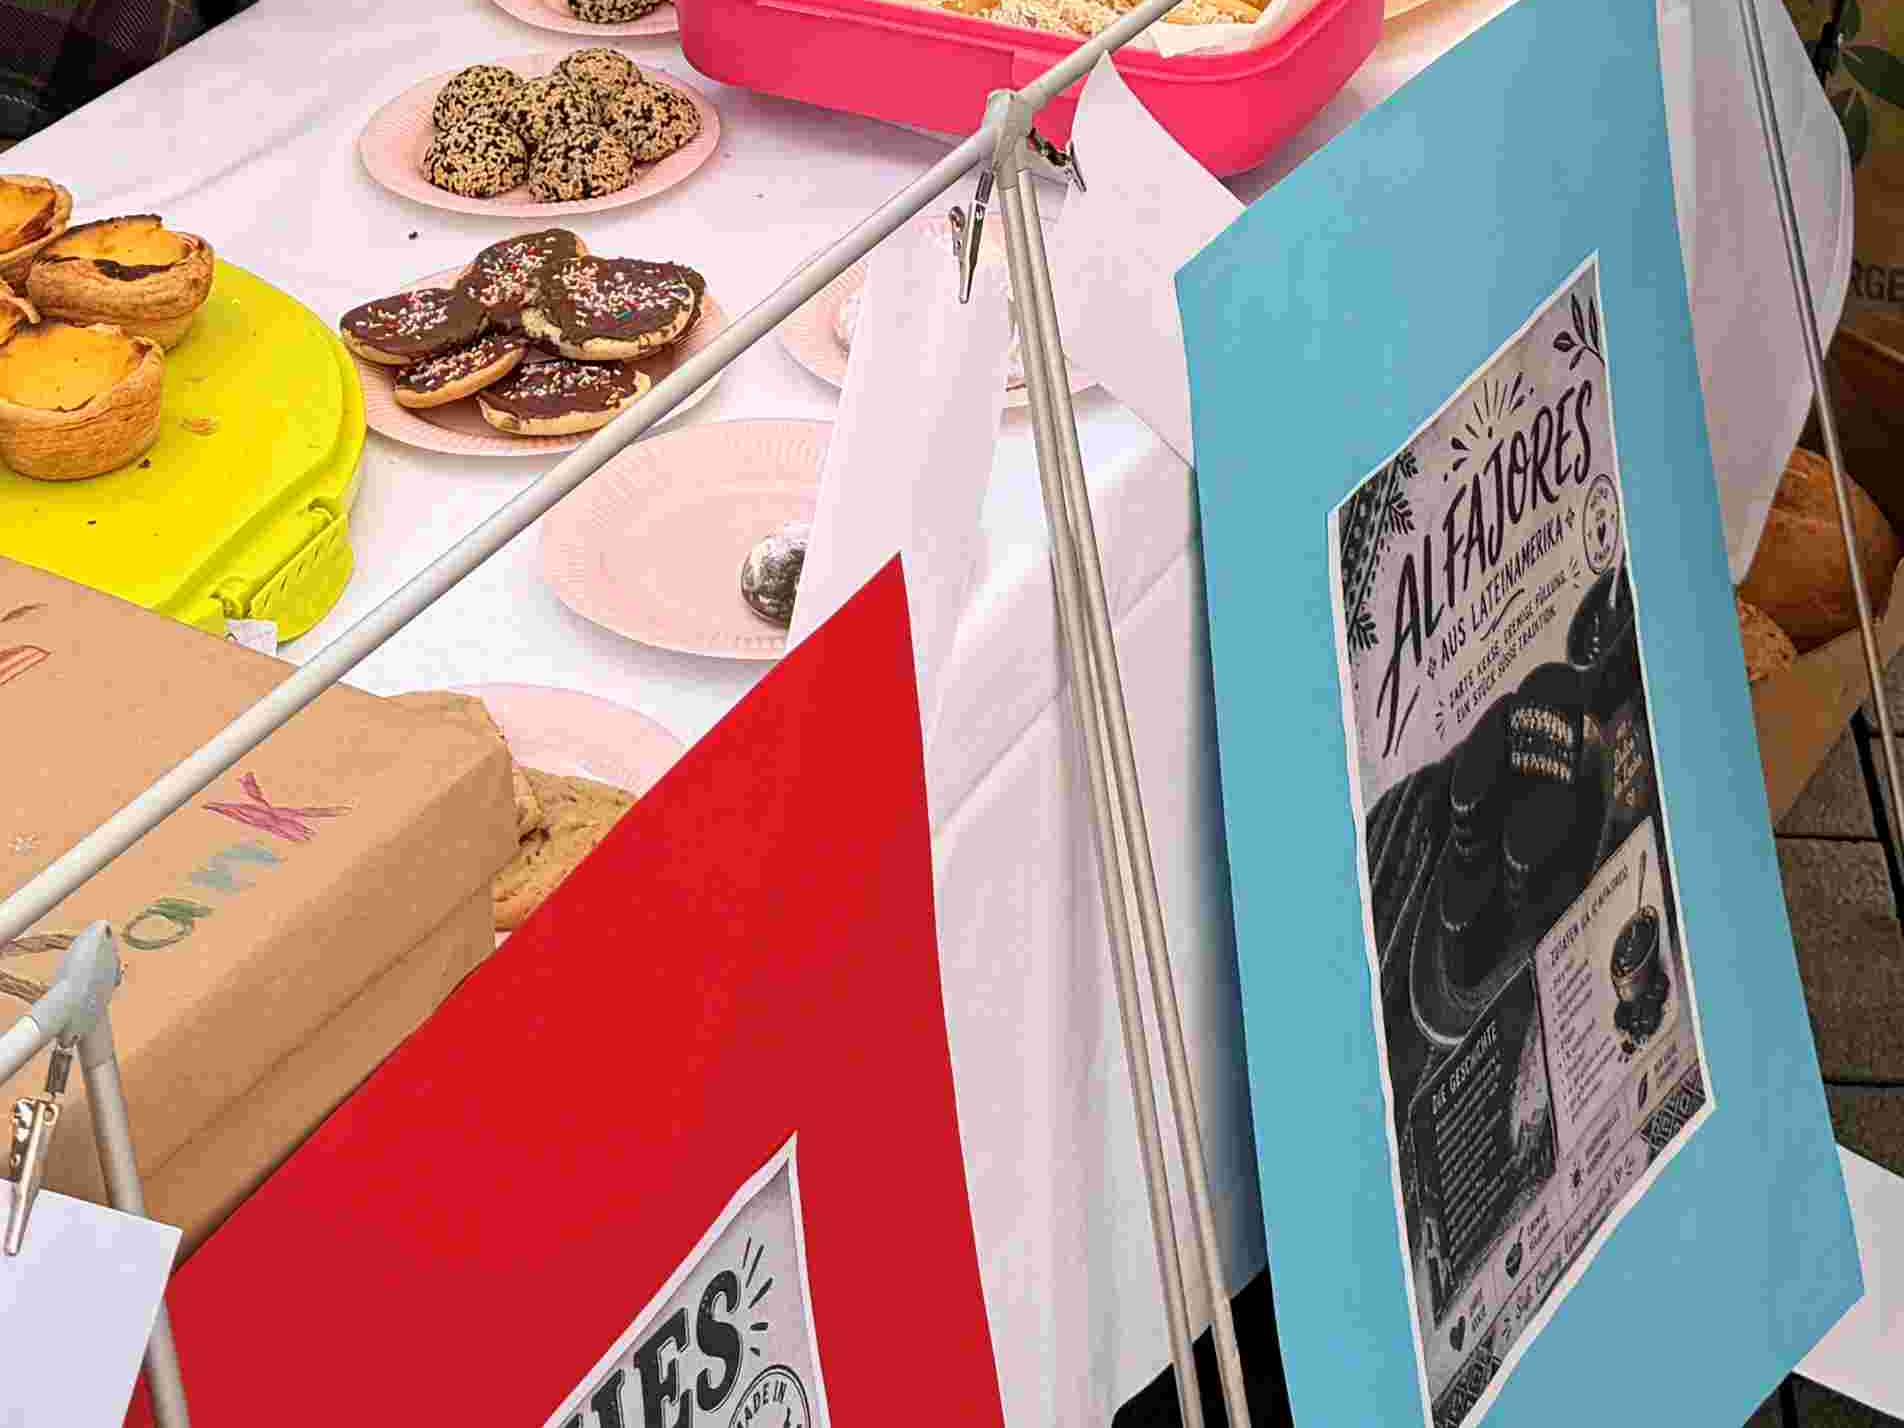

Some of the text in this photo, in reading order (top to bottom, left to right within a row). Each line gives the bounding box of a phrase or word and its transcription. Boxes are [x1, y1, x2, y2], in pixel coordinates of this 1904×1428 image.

[1377, 380, 1593, 759] ALFAJORES
[1440, 513, 1565, 671] AUS LATEINAMERIKA
[561, 1269, 743, 1428] IES
[737, 1383, 787, 1428] ADE IN
